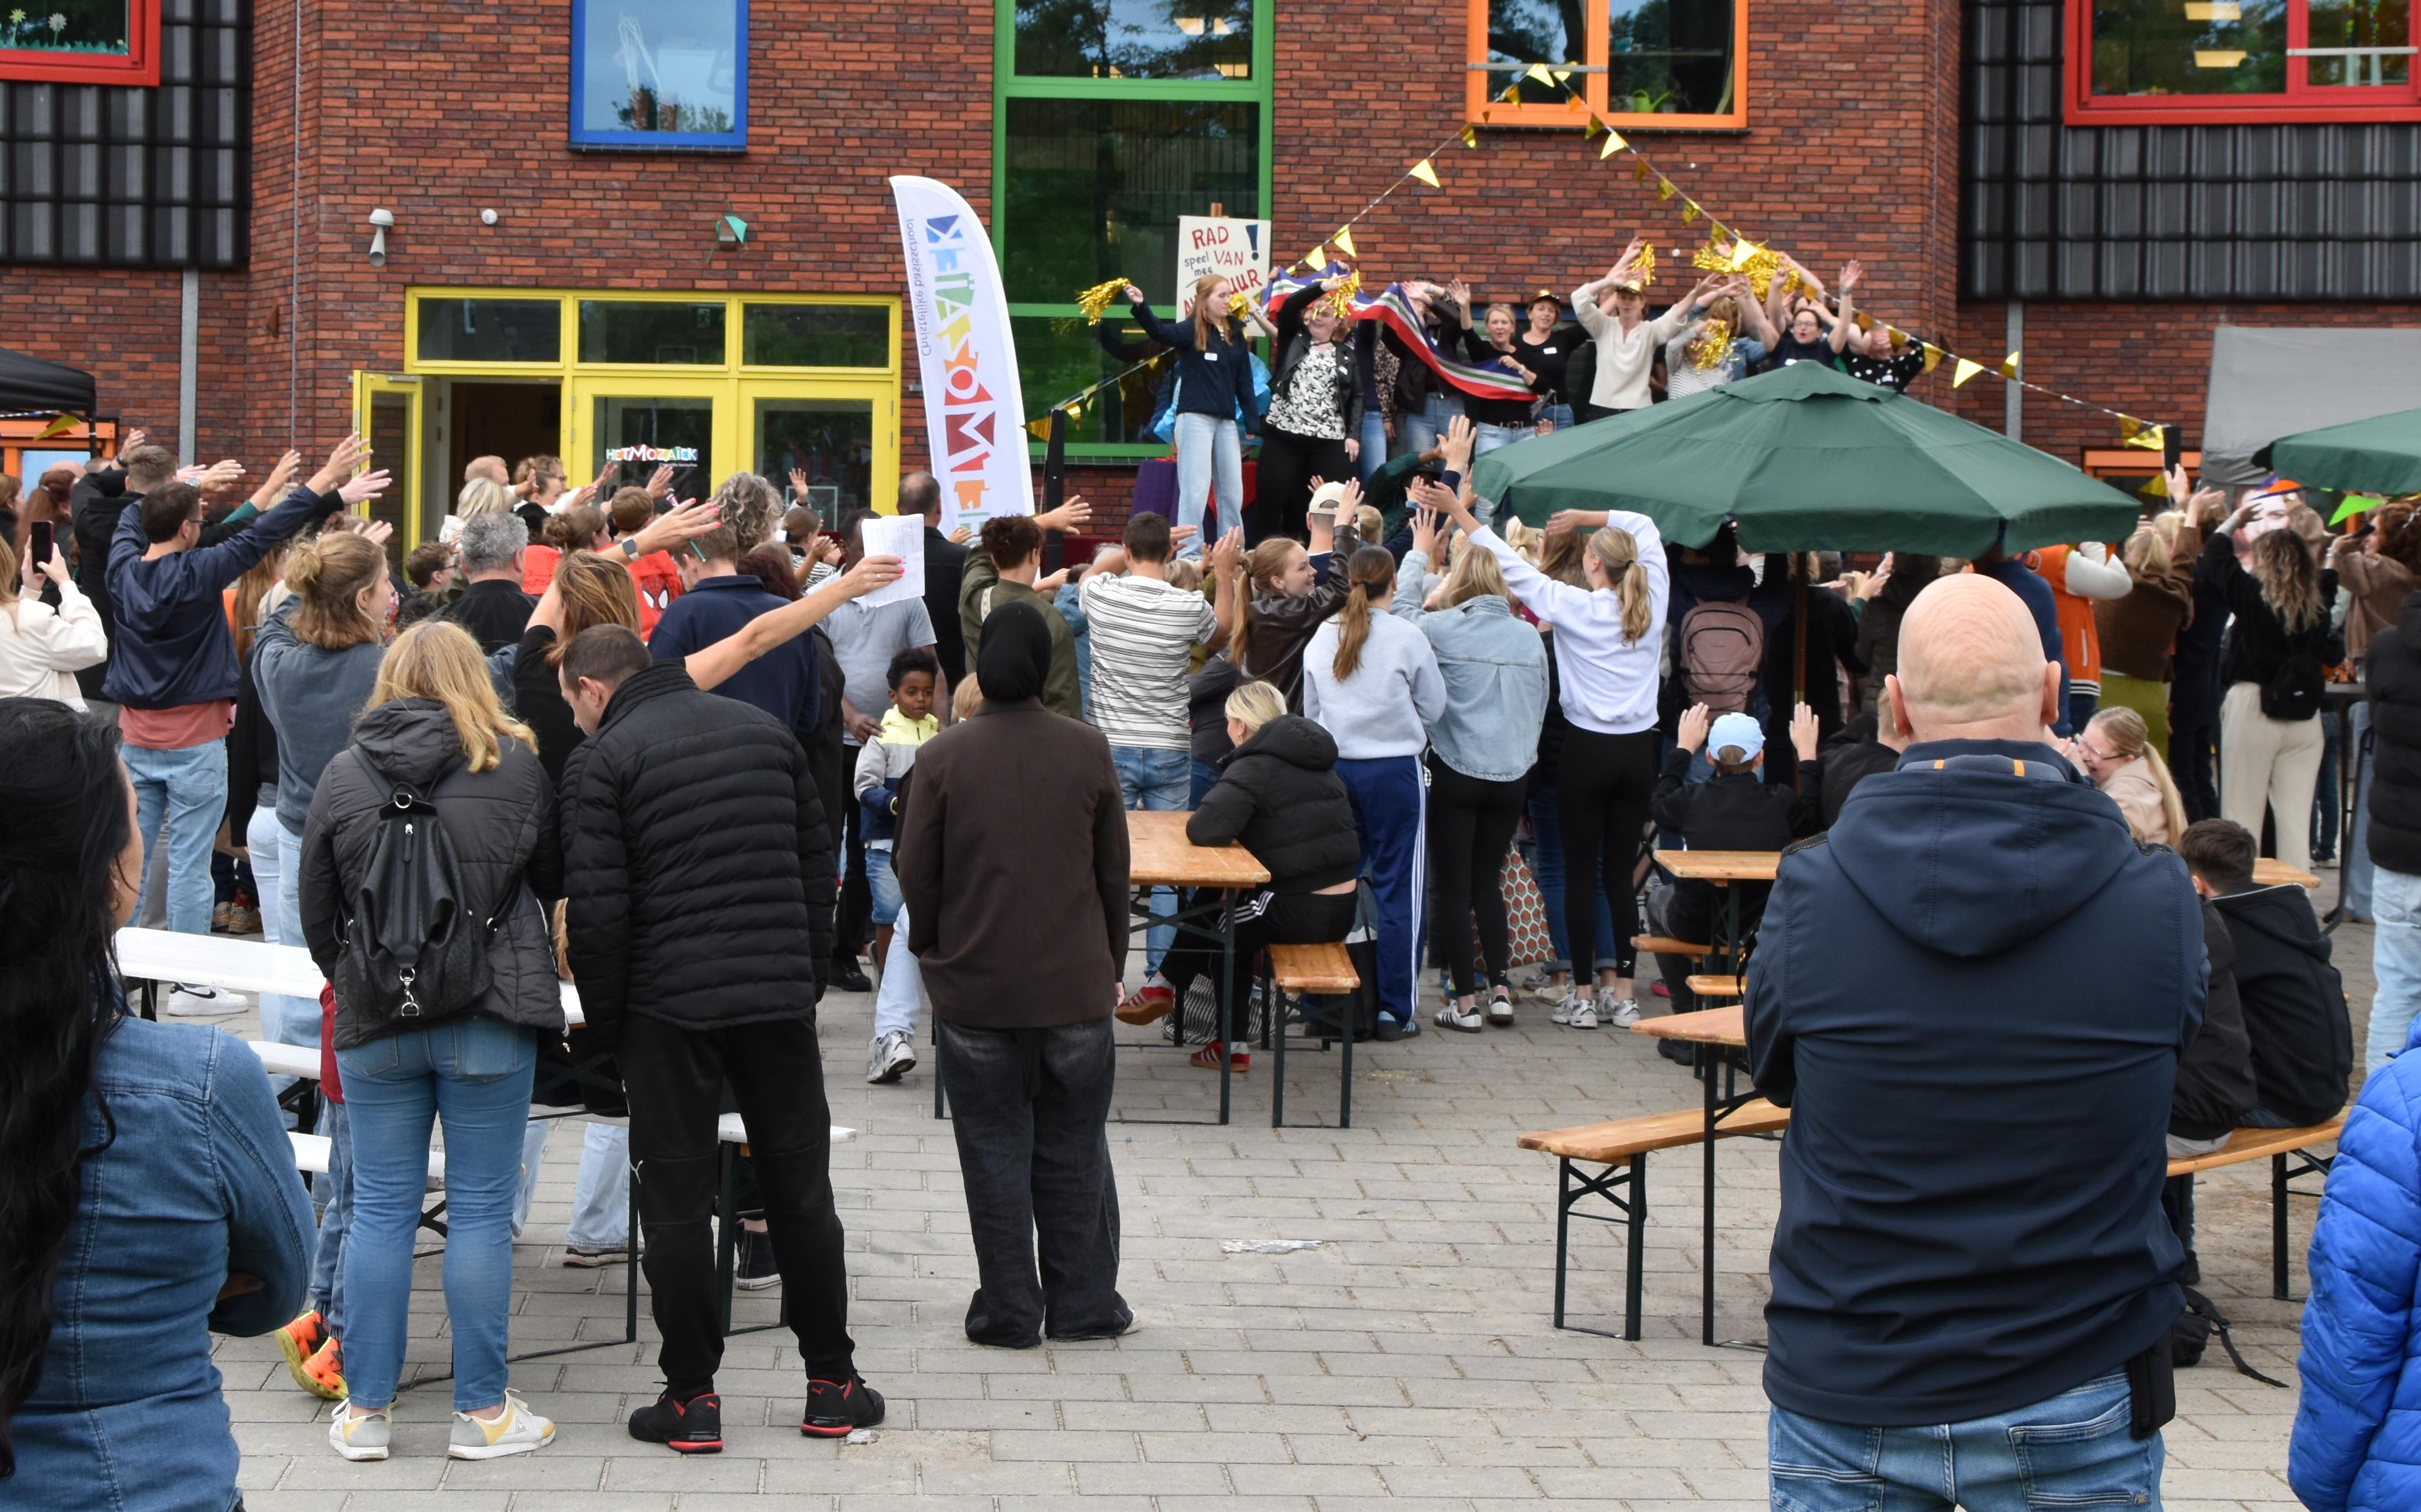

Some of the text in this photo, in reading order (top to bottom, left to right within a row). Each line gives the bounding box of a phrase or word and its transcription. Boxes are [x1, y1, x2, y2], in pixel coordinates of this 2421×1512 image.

[1192, 226, 1229, 249] RAD
[1184, 251, 1209, 270] speel
[1214, 250, 1243, 266] VAN
[1194, 267, 1213, 277] mee
